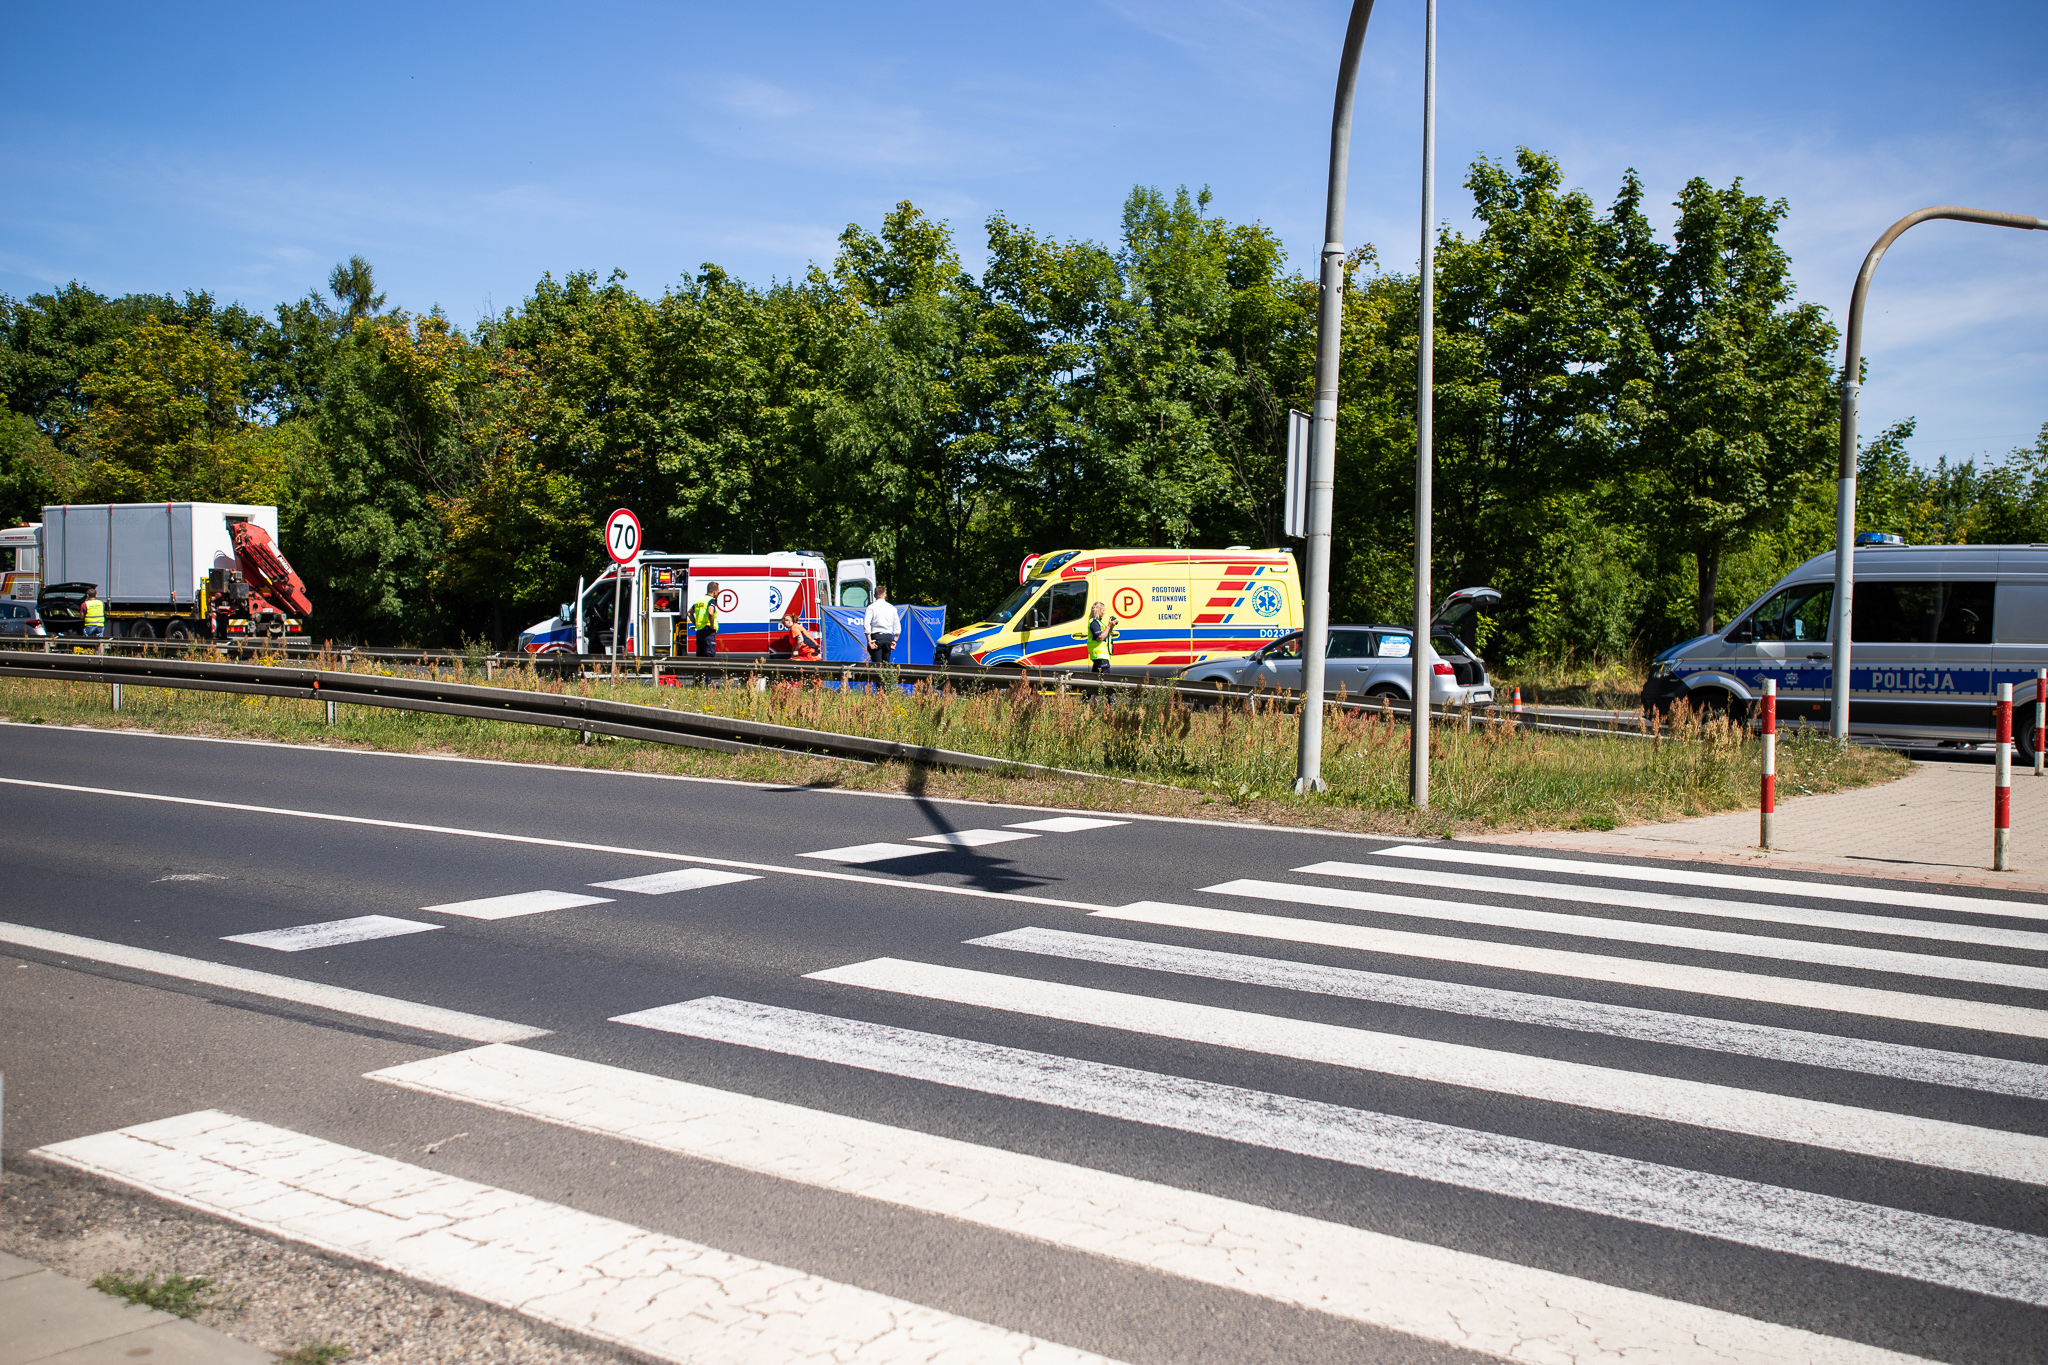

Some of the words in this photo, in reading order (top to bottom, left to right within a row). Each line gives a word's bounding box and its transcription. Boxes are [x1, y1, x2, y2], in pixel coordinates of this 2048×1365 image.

[614, 524, 635, 549] 70
[723, 594, 732, 608] P
[1124, 596, 1134, 611] P
[1872, 672, 1955, 690] POLICJA
